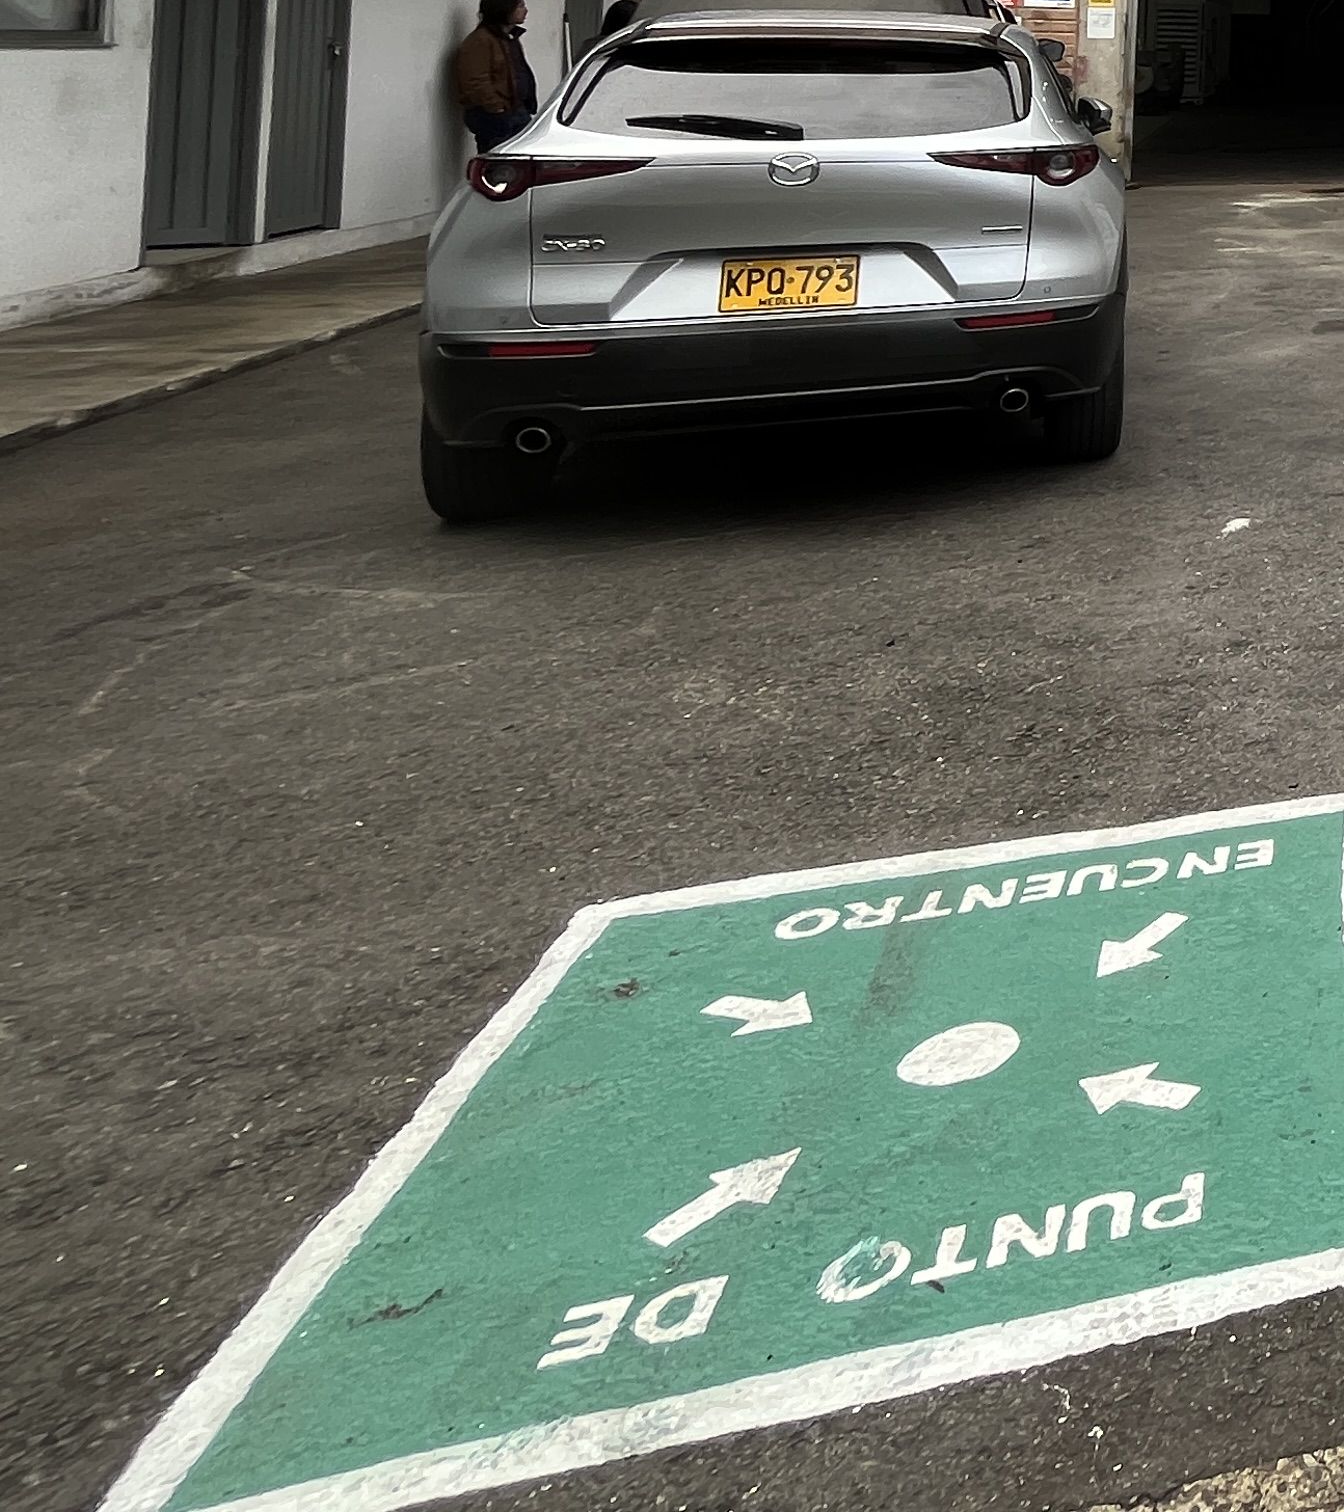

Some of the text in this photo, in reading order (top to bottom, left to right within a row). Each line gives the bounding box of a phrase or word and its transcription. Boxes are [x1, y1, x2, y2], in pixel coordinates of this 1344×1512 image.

[773, 838, 1276, 940] ENCUENTRO
[536, 1172, 1206, 1371] PUNTO DE
